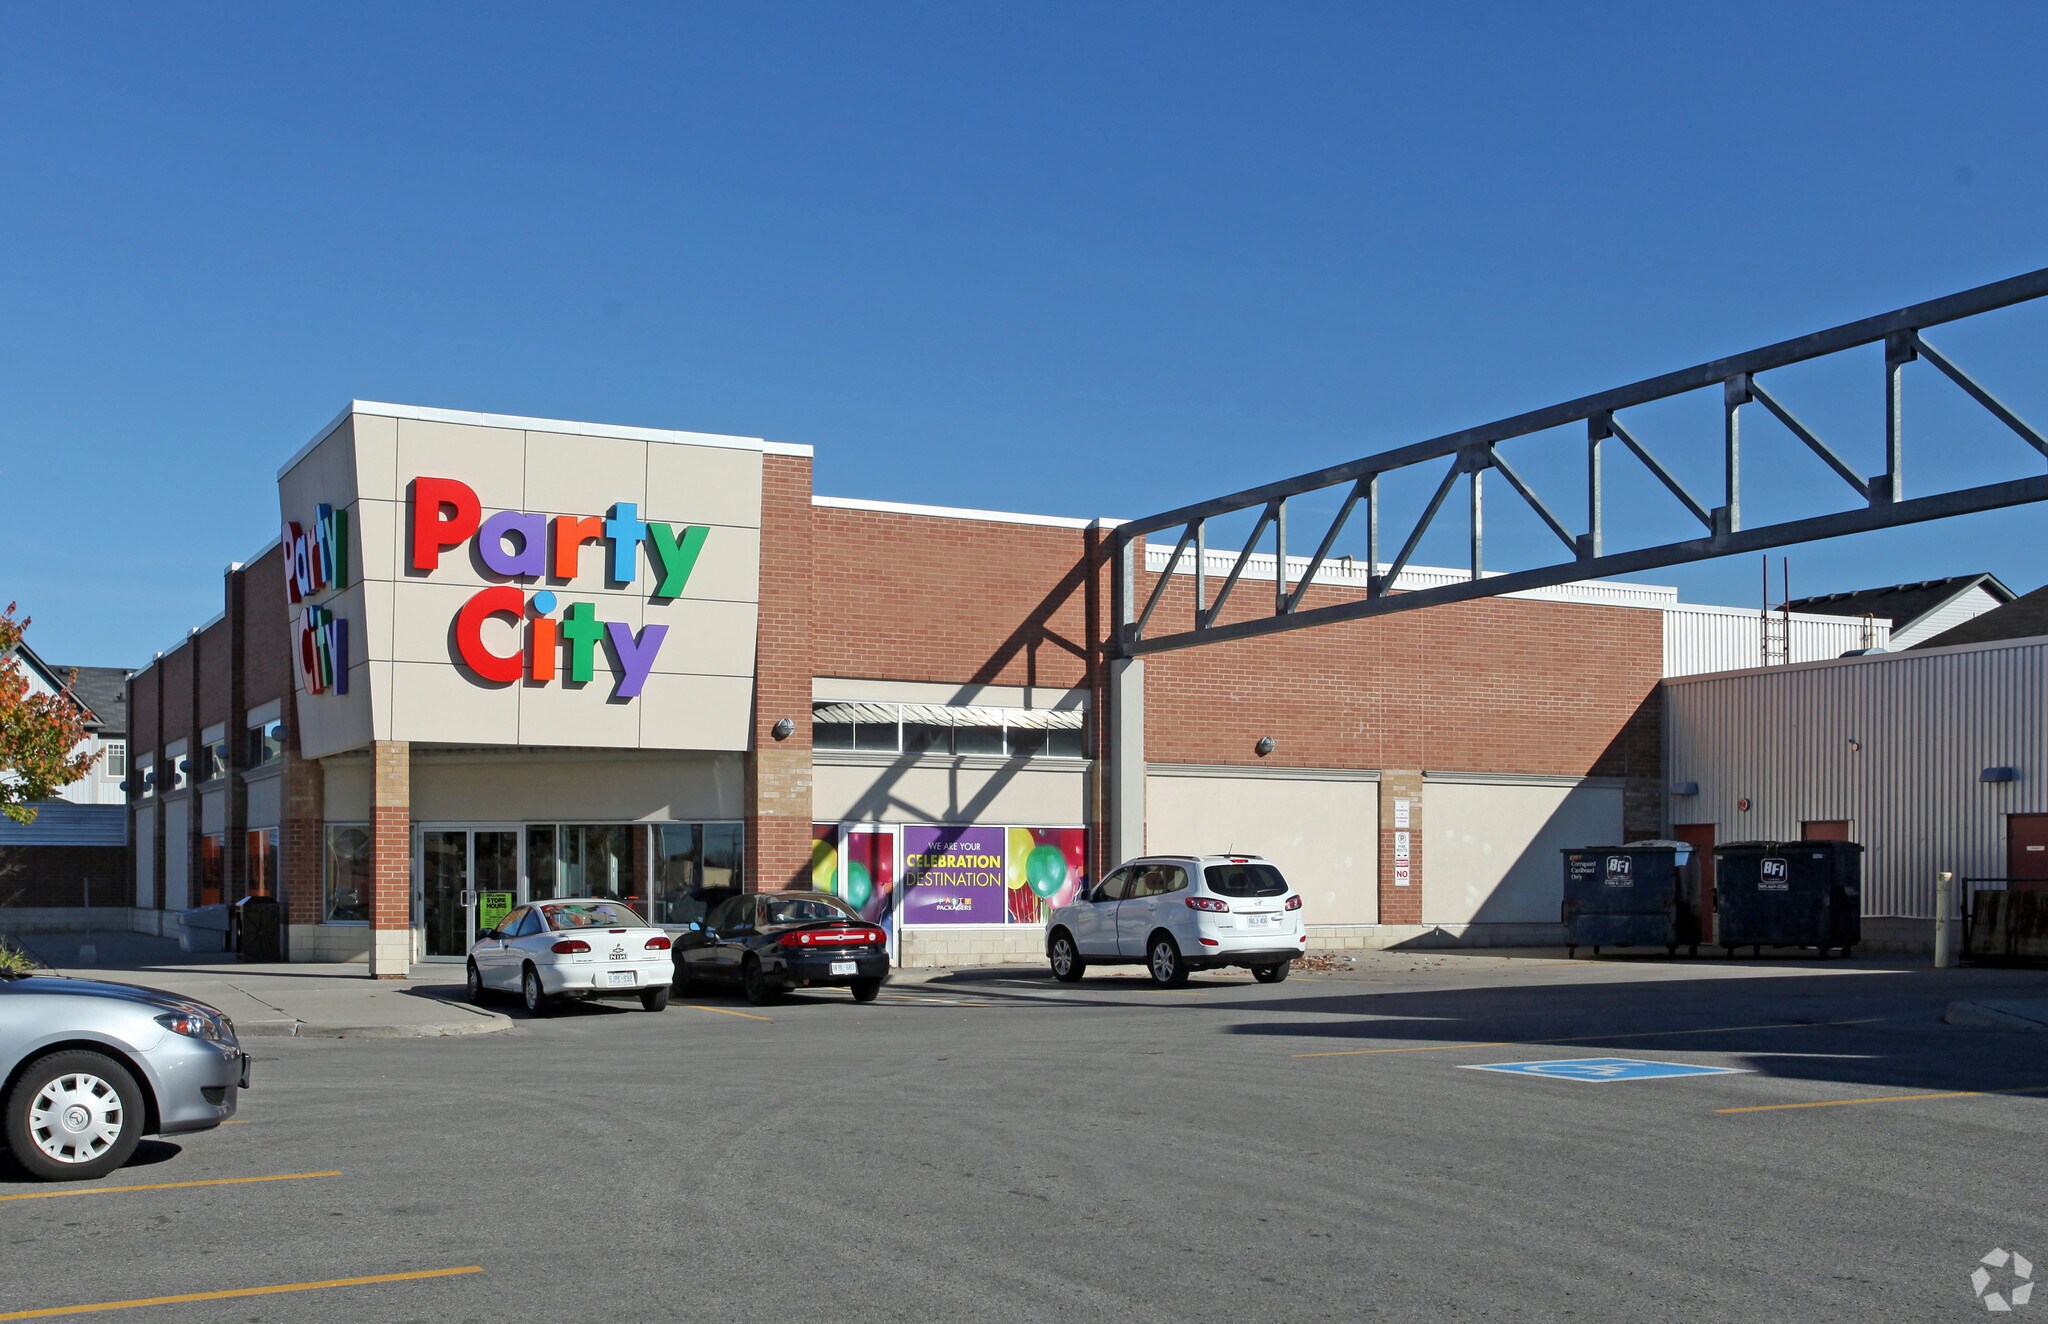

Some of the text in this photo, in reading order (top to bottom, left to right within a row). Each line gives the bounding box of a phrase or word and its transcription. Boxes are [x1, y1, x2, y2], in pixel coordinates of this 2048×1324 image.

[412, 476, 710, 597] Party
[281, 503, 347, 605] Party
[456, 586, 669, 697] City
[298, 605, 348, 696] City
[928, 842, 981, 851] WE ARE YOUR
[906, 853, 1001, 868] CELEBRATION
[1609, 858, 1630, 874] BFI
[1396, 870, 1408, 878] NO
[1763, 861, 1785, 877] BFI
[906, 872, 1001, 887] DESTINATION
